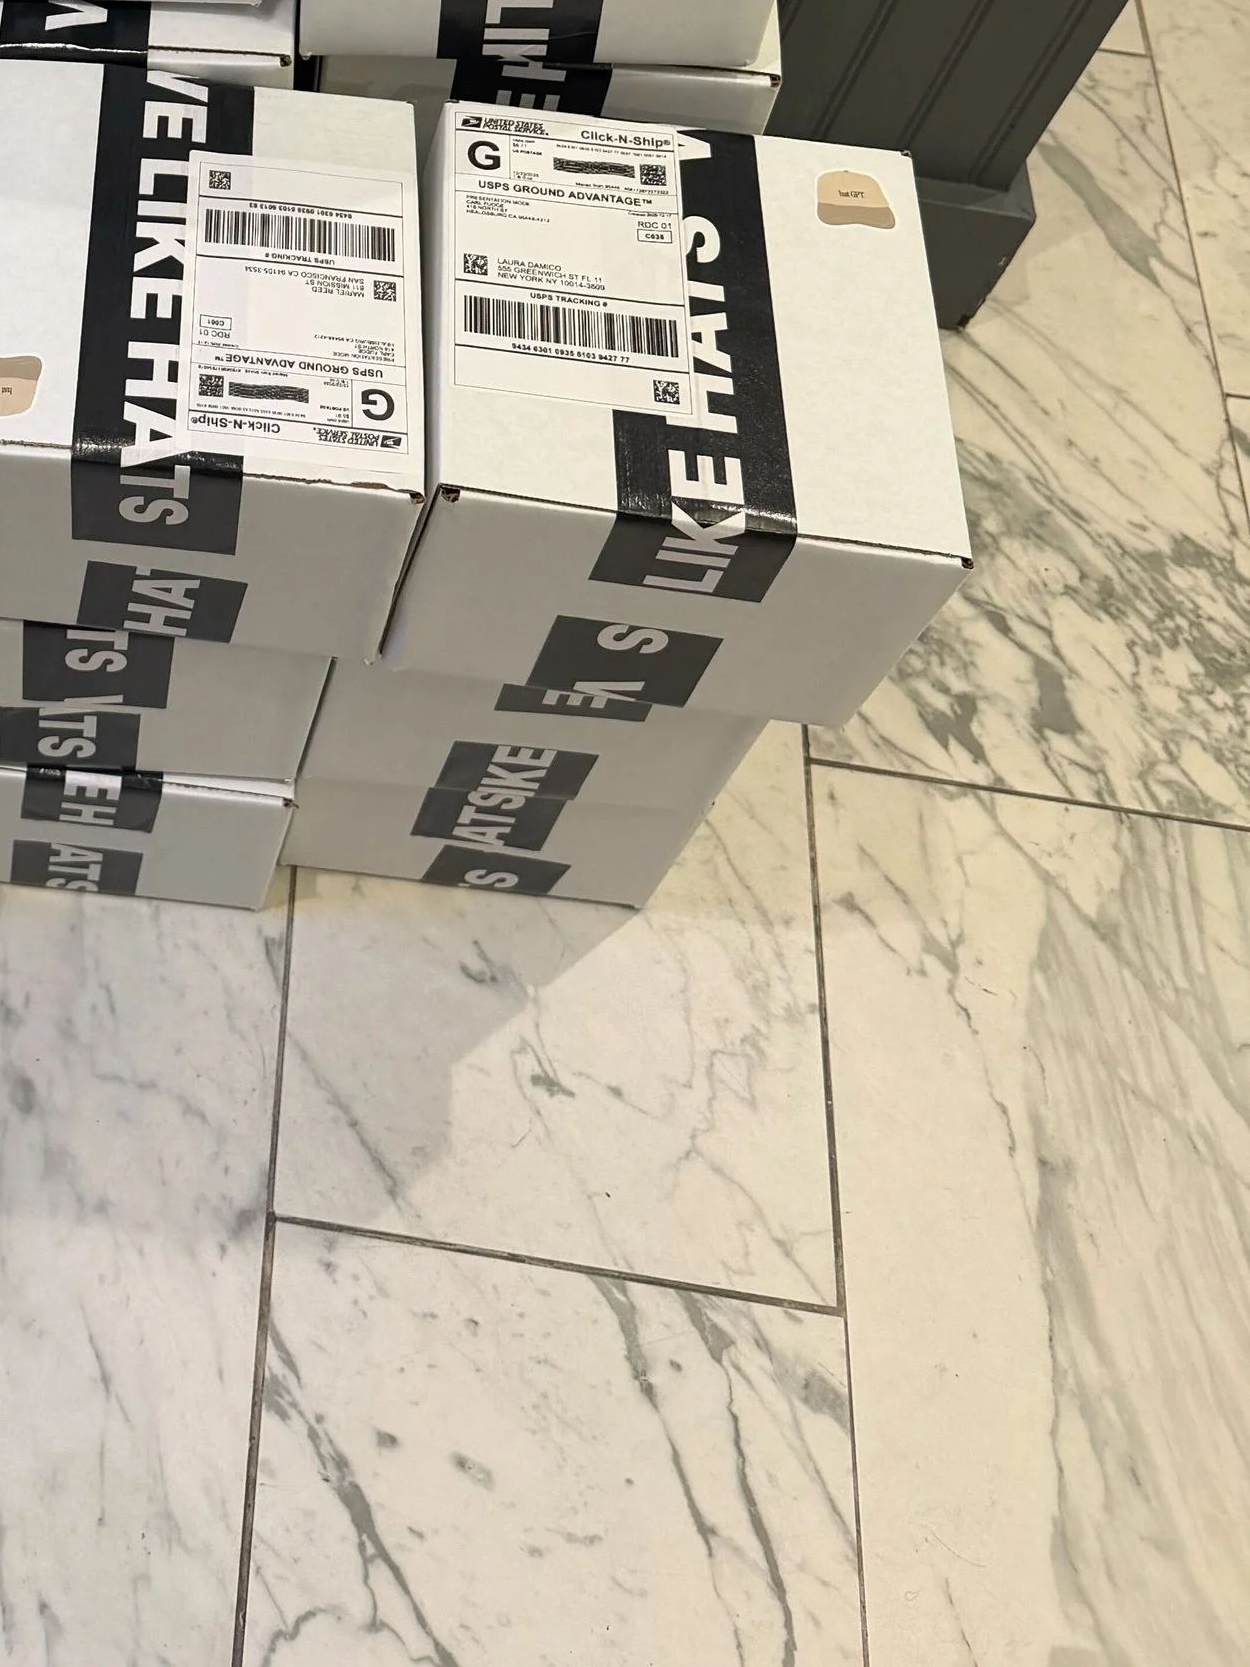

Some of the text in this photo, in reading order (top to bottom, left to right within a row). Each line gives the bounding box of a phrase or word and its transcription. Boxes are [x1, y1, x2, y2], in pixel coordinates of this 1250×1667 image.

[466, 139, 501, 171] G
[477, 179, 510, 192] USPS
[512, 183, 565, 198] GROUND
[636, 220, 673, 232] RDC 01
[270, 252, 335, 265] USPS TRACKING
[299, 270, 347, 283] FRANCISCO
[512, 266, 567, 279] GREENWICH
[529, 291, 601, 308] USPS TRACKING
[118, 156, 192, 526] LIKE HATS
[198, 328, 231, 339] RDC 01
[297, 360, 349, 375] GROUND
[351, 366, 383, 379] USPS
[360, 387, 395, 422] G
[643, 451, 746, 594] LIKE
